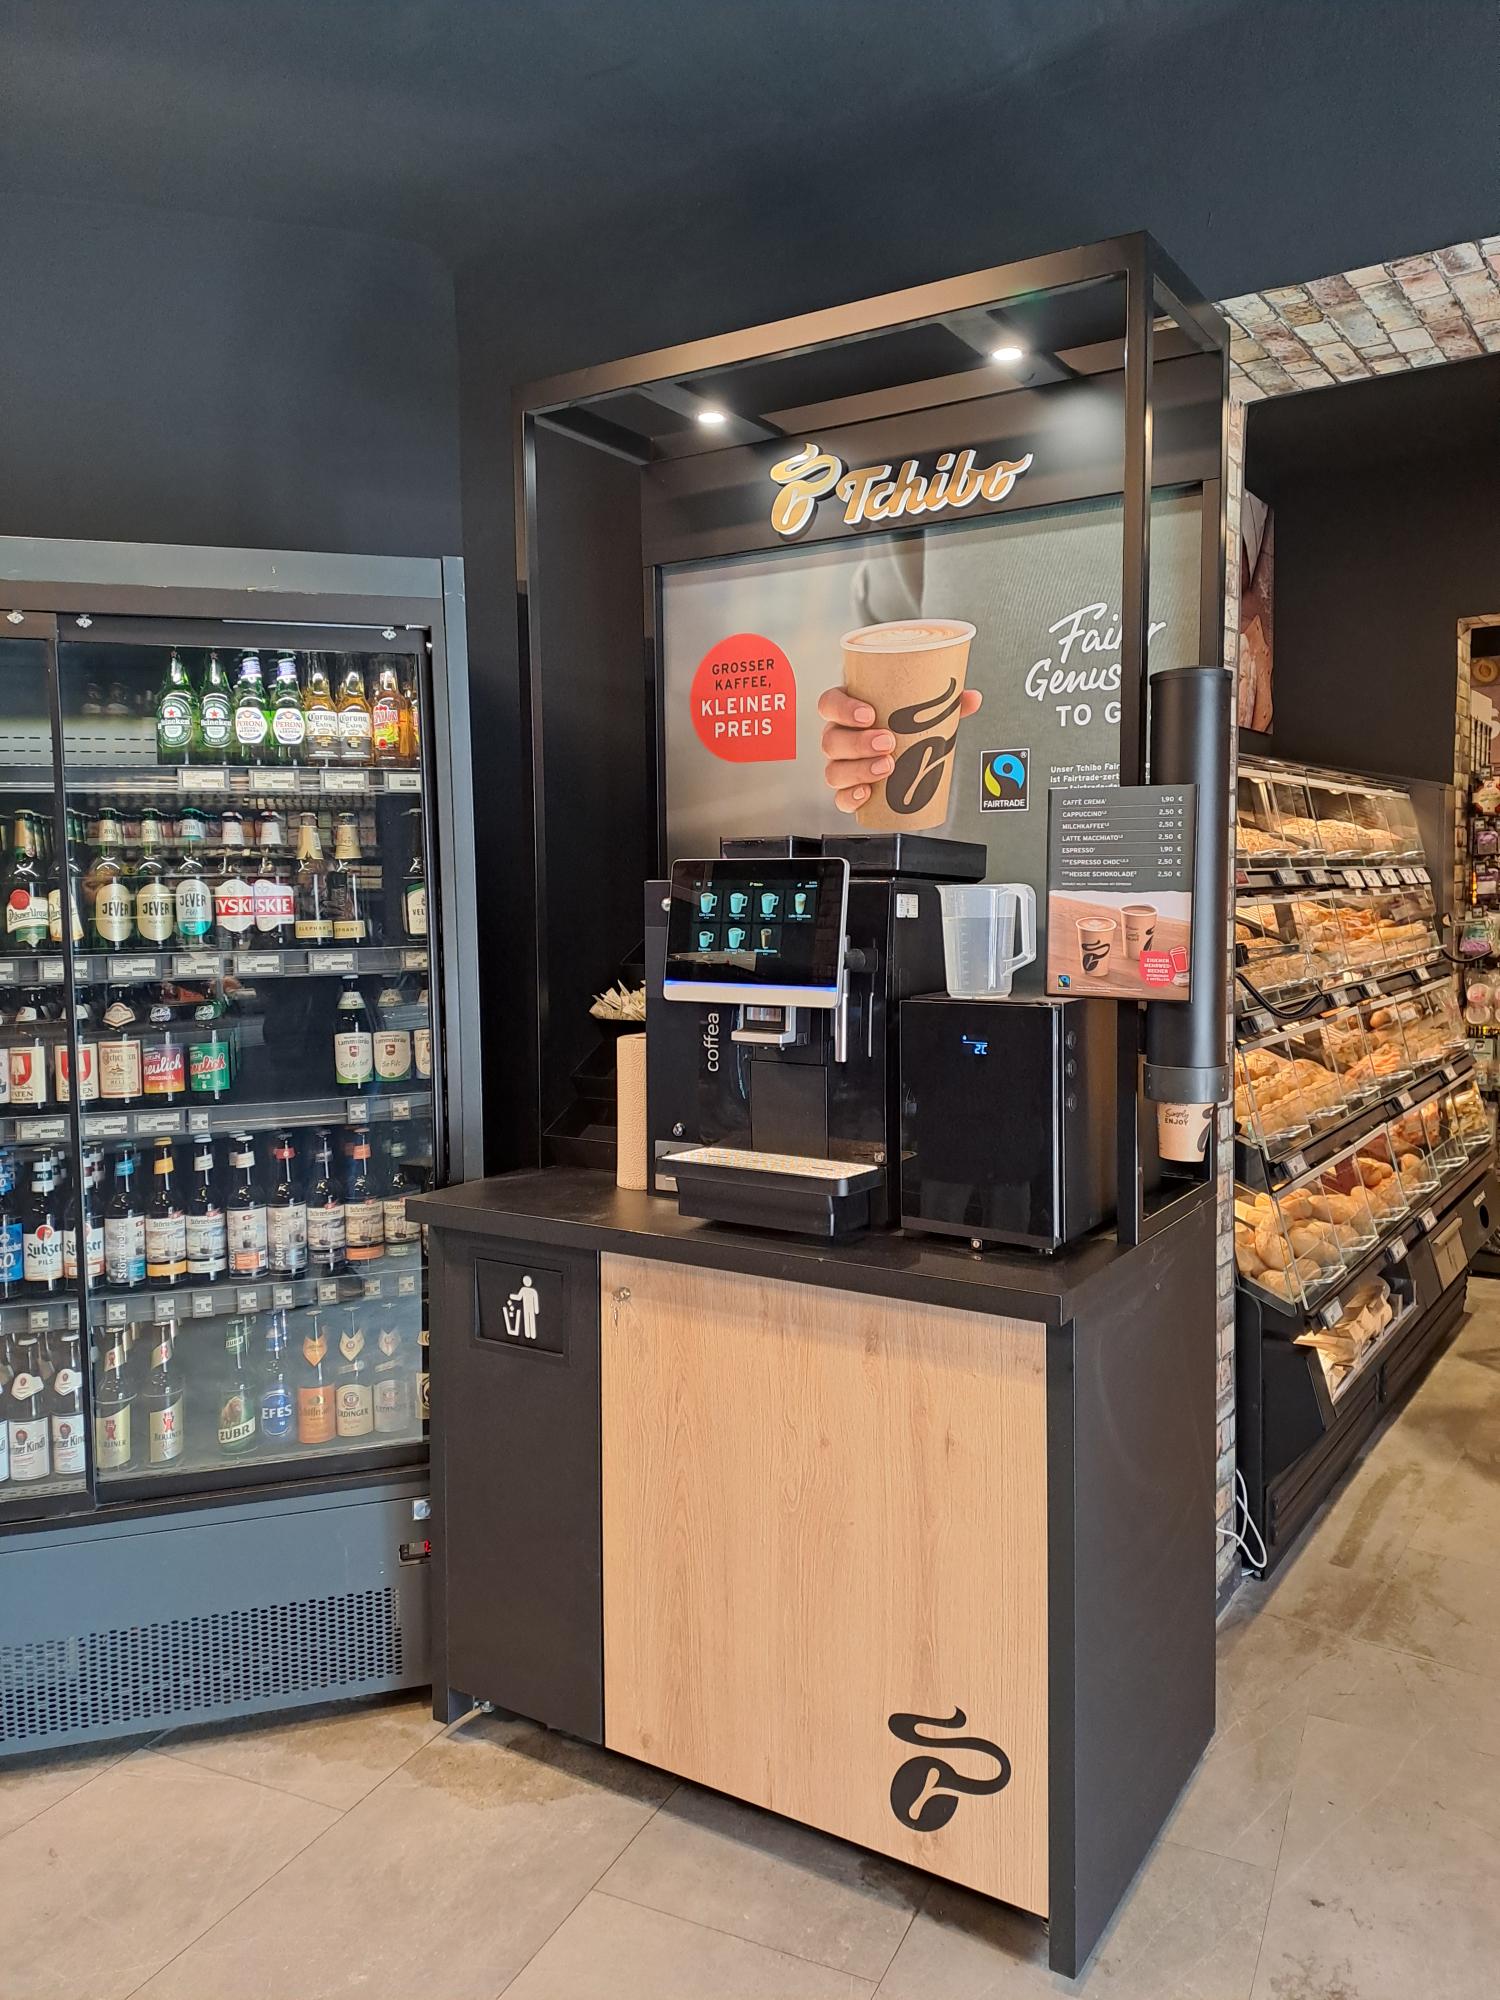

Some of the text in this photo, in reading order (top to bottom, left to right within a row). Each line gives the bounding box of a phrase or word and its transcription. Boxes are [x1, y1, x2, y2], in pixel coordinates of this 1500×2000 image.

[836, 449, 1034, 525] Tchibo
[712, 658, 775, 675] GROSSER
[715, 676, 772, 691] KAFFEE,
[1025, 657, 1122, 702] Genus
[701, 693, 786, 717] KLEINER
[308, 713, 336, 722] Corona
[340, 714, 367, 723] Corona
[1056, 701, 1122, 727] TO G
[715, 718, 773, 738] PREIS
[1050, 762, 1120, 774] Unser Tchibo Fair
[1063, 772, 1120, 782] Fairtrade-zert
[983, 799, 1026, 808] FAIRTRADE
[179, 893, 206, 908] JEVER
[217, 899, 254, 914] YSKI
[256, 898, 291, 913] SKIE
[30, 907, 48, 920] Urque
[102, 901, 129, 917] JEVER
[142, 901, 170, 917] JEVER
[412, 908, 425, 916] VEL
[703, 1013, 719, 1072] coffea
[144, 1053, 182, 1075] neulich
[1164, 1117, 1189, 1126] ENJOY
[262, 1404, 293, 1419] EFES
[70, 1432, 83, 1447] Kin
[220, 1424, 250, 1440] ZUBR
[26, 1434, 46, 1453] Kindl
